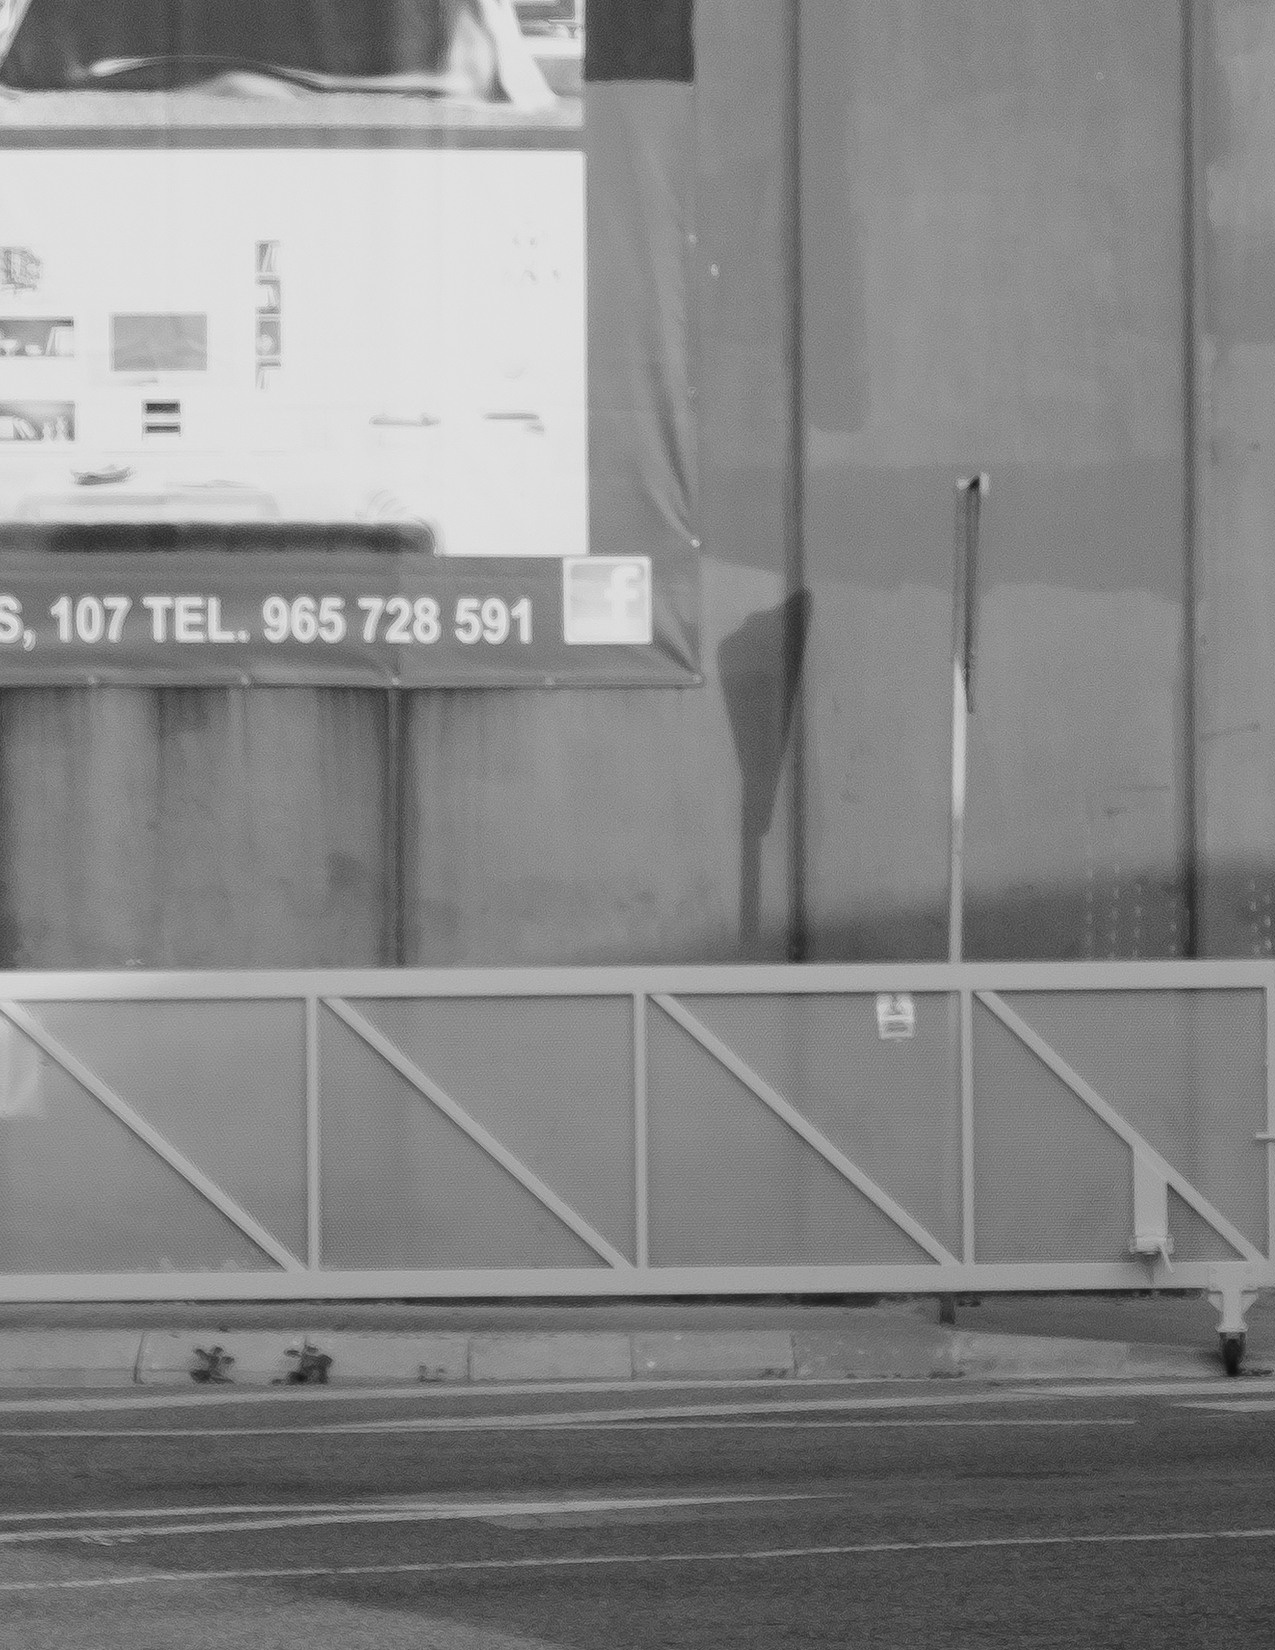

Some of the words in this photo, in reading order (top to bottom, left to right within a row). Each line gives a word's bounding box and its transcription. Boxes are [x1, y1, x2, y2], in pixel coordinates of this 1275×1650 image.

[50, 596, 132, 643] 107
[143, 596, 249, 643] TEL.
[262, 596, 346, 643] 965
[358, 597, 441, 644] 728
[455, 598, 532, 644] 591
